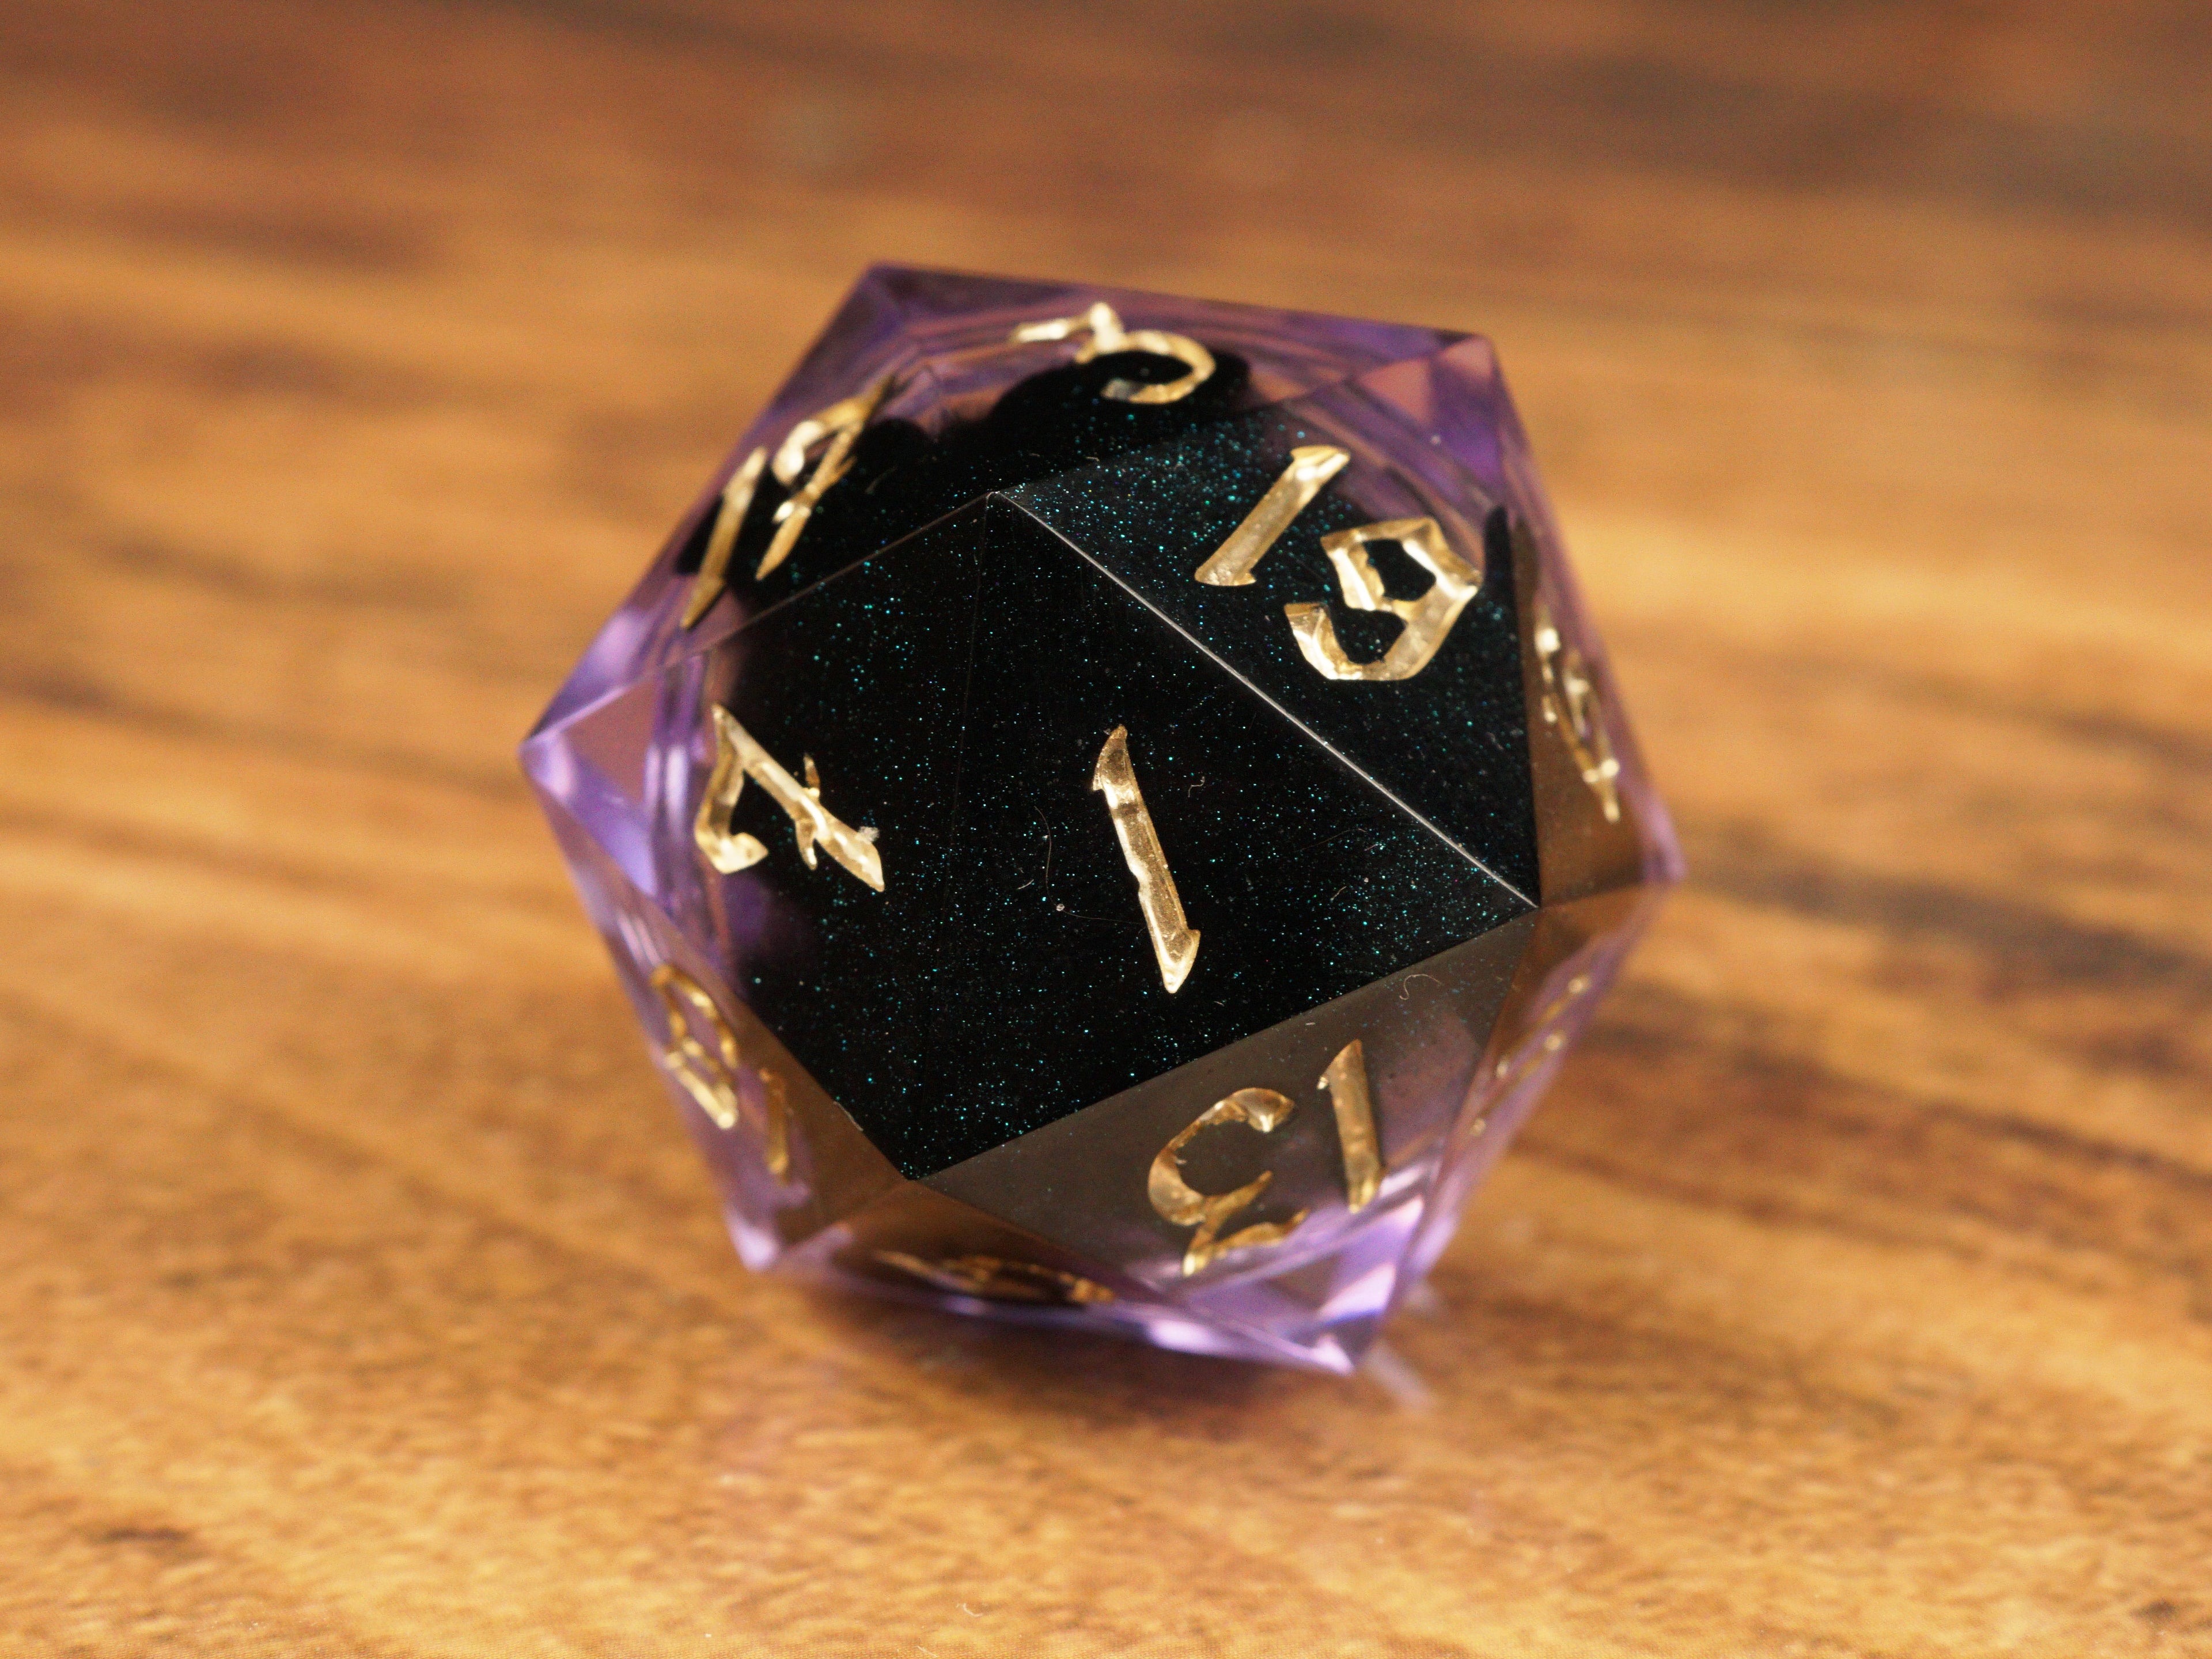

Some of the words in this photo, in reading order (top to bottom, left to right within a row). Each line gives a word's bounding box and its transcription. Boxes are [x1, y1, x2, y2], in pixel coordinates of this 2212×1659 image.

[1009, 300, 1217, 404] 3
[679, 374, 896, 630] 17
[1194, 444, 1485, 682] 19
[694, 703, 885, 892] 7
[1092, 723, 1200, 994] 1
[1147, 1038, 1384, 1278] 13
